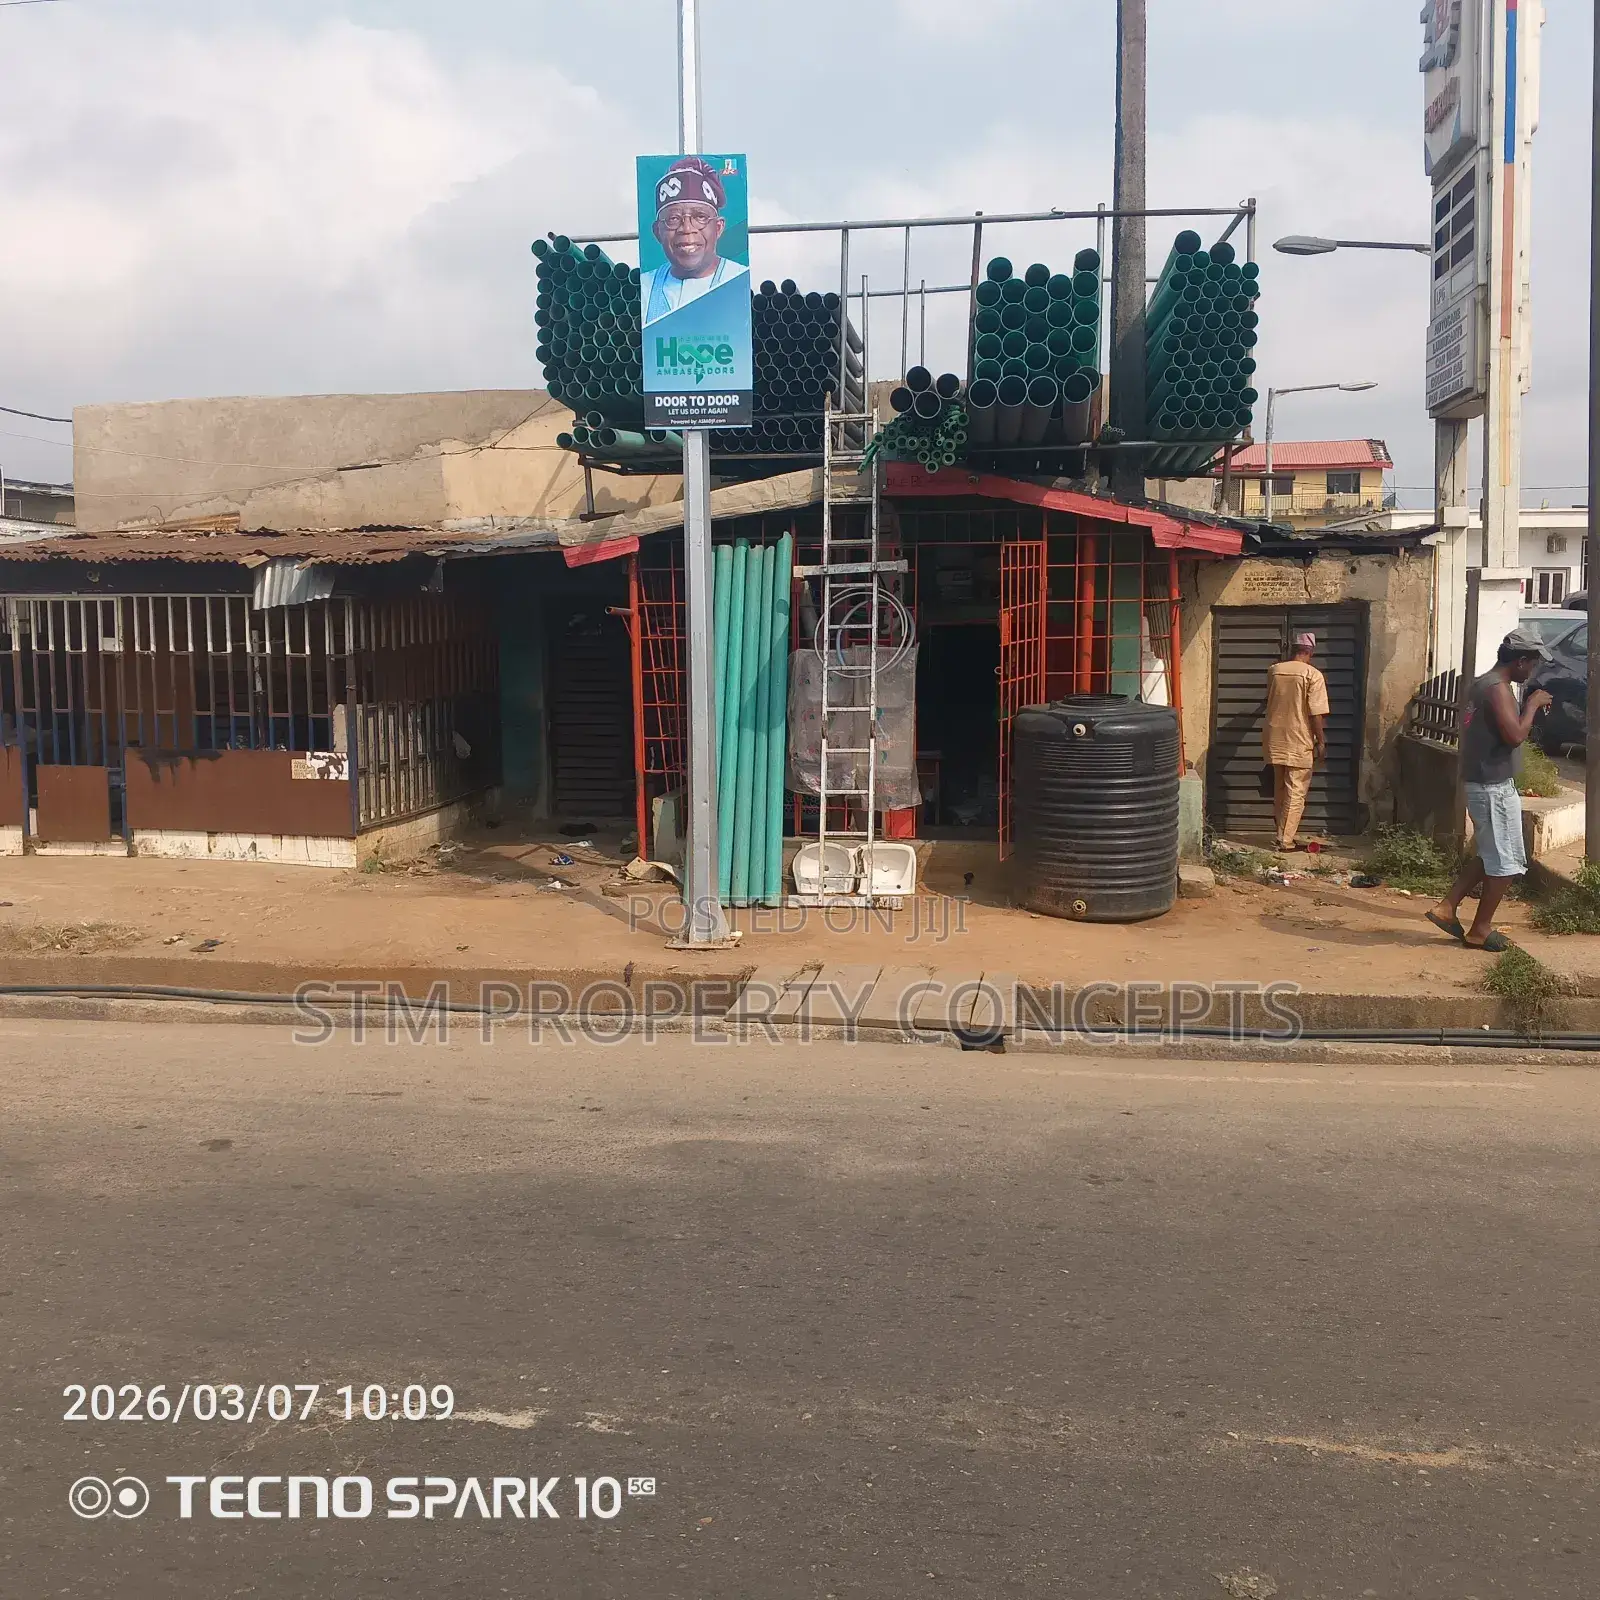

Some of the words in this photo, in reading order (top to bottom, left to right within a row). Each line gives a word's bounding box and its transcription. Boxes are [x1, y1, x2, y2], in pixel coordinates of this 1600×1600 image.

[1436, 287, 1445, 305] LPG
[657, 367, 734, 375] AMBASSADORS
[655, 396, 687, 407] DOOR
[689, 396, 705, 406] TO
[707, 395, 739, 406] DOOR
